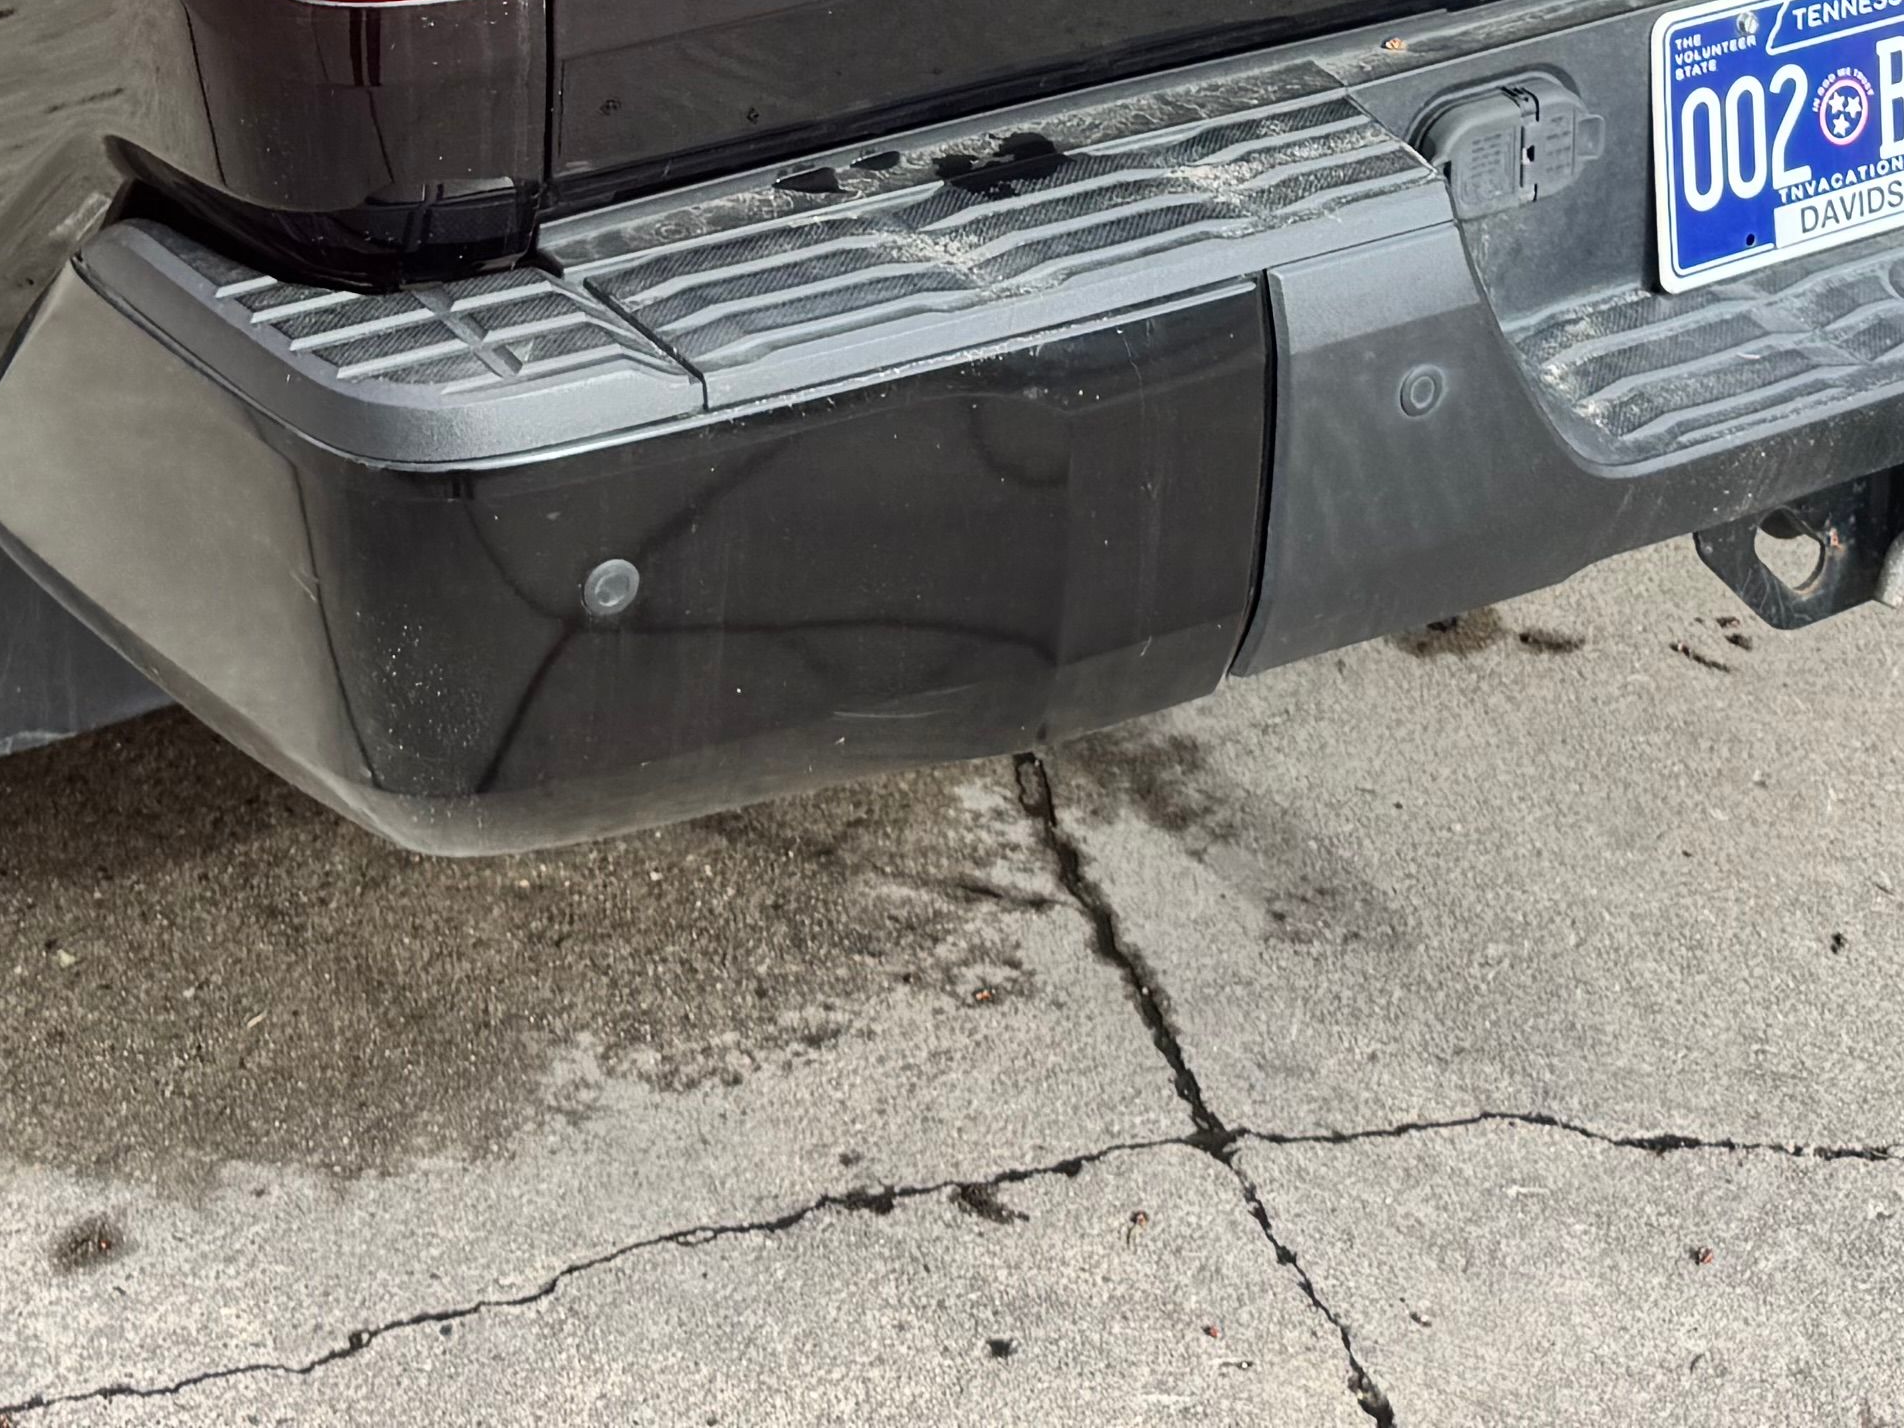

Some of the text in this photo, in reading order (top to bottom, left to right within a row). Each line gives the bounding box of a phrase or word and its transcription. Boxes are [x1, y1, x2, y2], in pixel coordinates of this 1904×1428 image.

[1675, 34, 1701, 50] THE
[1675, 35, 1757, 65] VOLUNTEER
[1675, 59, 1717, 81] STATE
[1680, 63, 1812, 212] 002
